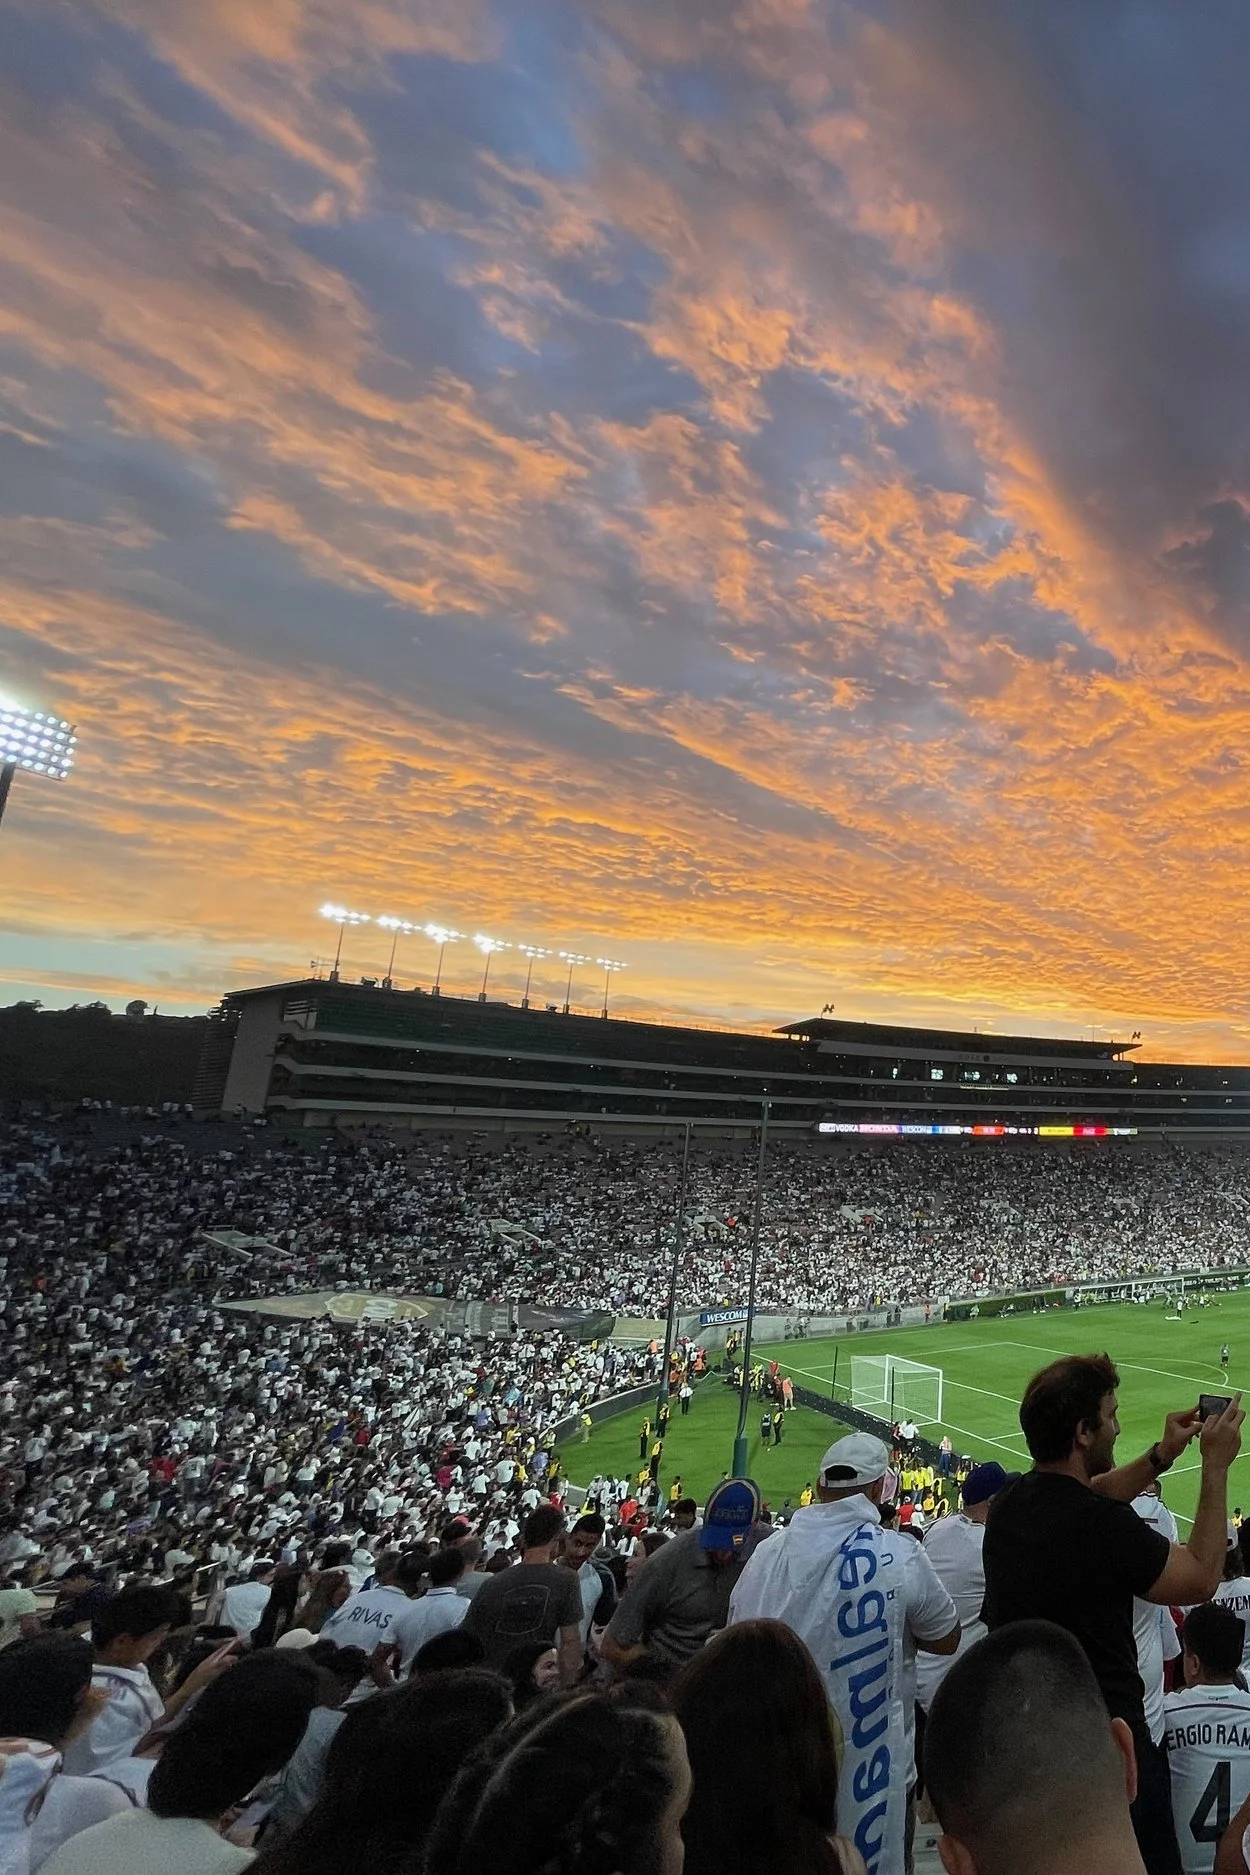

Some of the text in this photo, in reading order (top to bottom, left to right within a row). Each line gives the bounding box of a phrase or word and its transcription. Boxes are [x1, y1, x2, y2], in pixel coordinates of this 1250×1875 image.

[706, 1309, 743, 1323] WESCOM
[347, 1605, 393, 1629] RIVAS
[1188, 1760, 1232, 1844] 4
